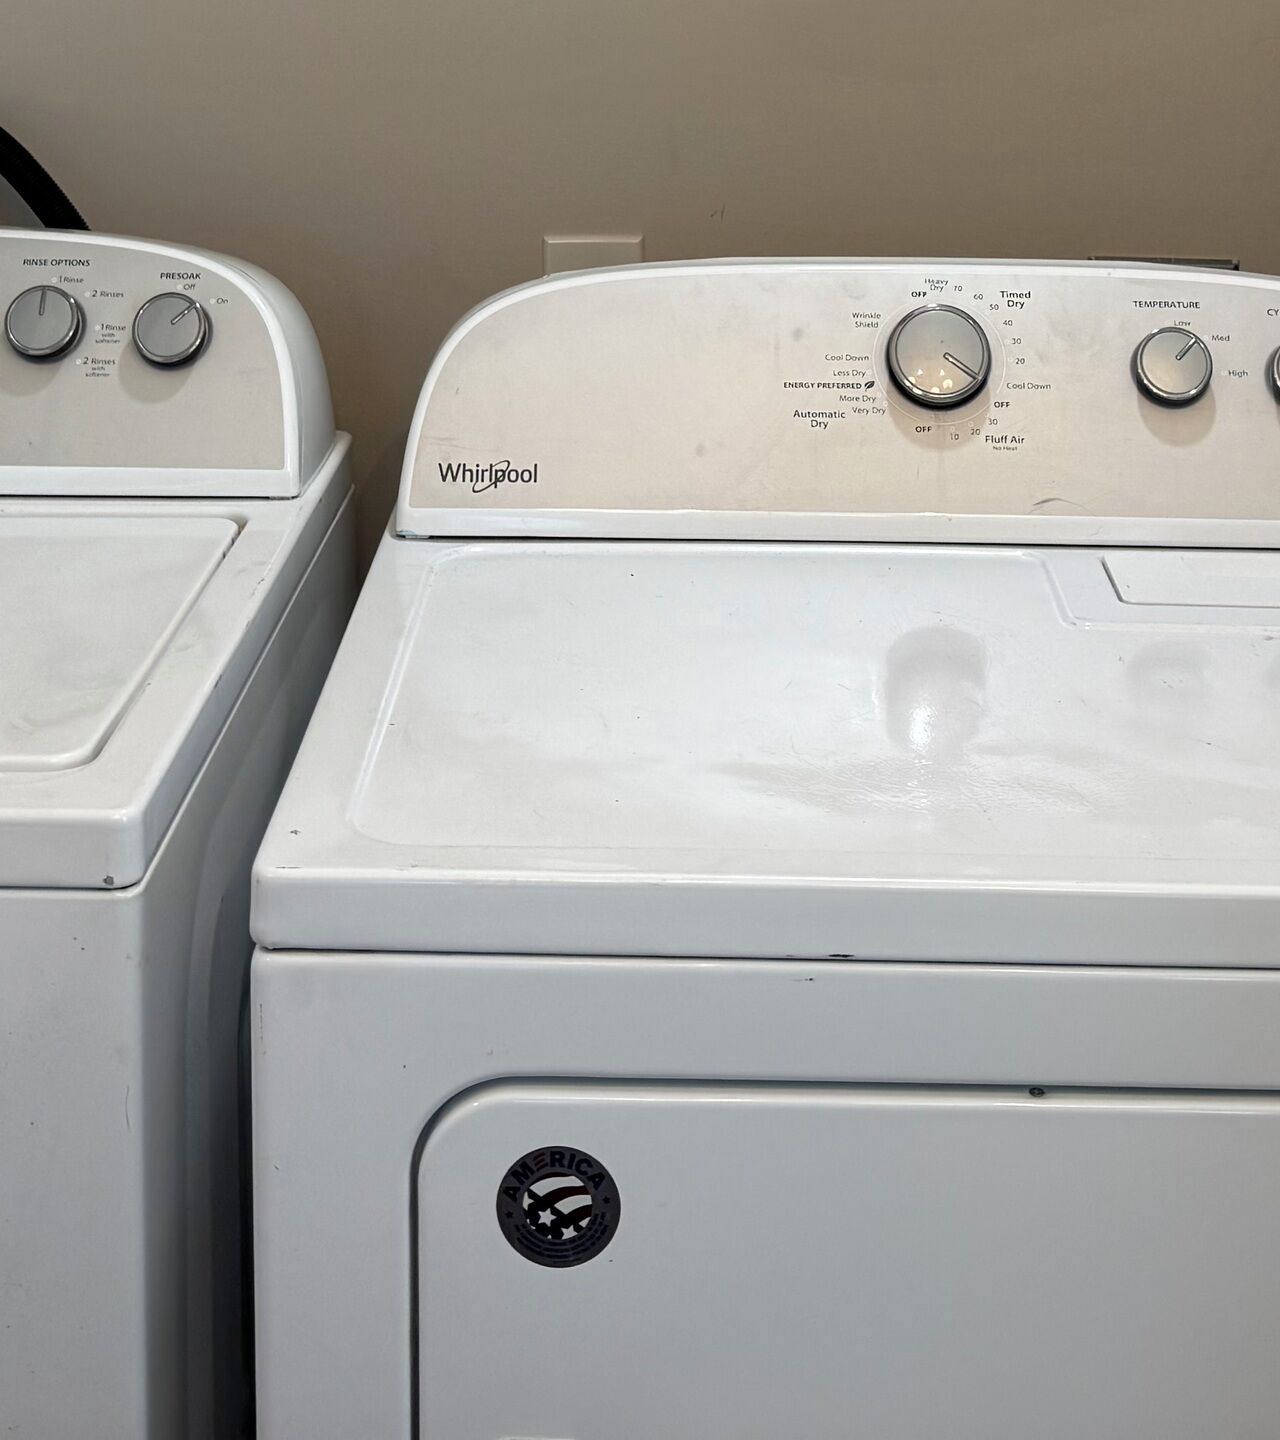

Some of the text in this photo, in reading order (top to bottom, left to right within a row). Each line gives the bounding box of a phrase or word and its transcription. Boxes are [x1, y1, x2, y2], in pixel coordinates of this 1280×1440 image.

[50, 259, 91, 267] OPTIONS
[160, 272, 201, 280] PRESOAK
[183, 283, 196, 291] Off
[91, 289, 98, 297] 2
[973, 293, 984, 301] 60
[1000, 290, 1031, 299] Timed
[216, 297, 229, 305] On
[1007, 300, 1025, 309] Dry
[1132, 300, 1201, 309] TEMPERATURE
[989, 303, 1000, 311] 50
[851, 312, 882, 320] Wrinkle
[1002, 319, 1013, 327] 40
[82, 357, 89, 365] 2
[1015, 357, 1026, 365] 20
[833, 369, 867, 378] Less Dry
[1228, 369, 1249, 378] High
[783, 381, 862, 390] ENERGY PREFERRED
[1006, 382, 1052, 390] Cool Down
[862, 395, 877, 404] Dry
[793, 409, 846, 419] Automatic
[851, 406, 886, 416] Very Dry
[810, 419, 829, 430] Dry
[970, 428, 981, 436] 20
[950, 433, 960, 441] 10
[985, 435, 1025, 444] Fluff Air
[438, 460, 538, 493] Whirlpool
[502, 1150, 606, 1203] AMERICA
